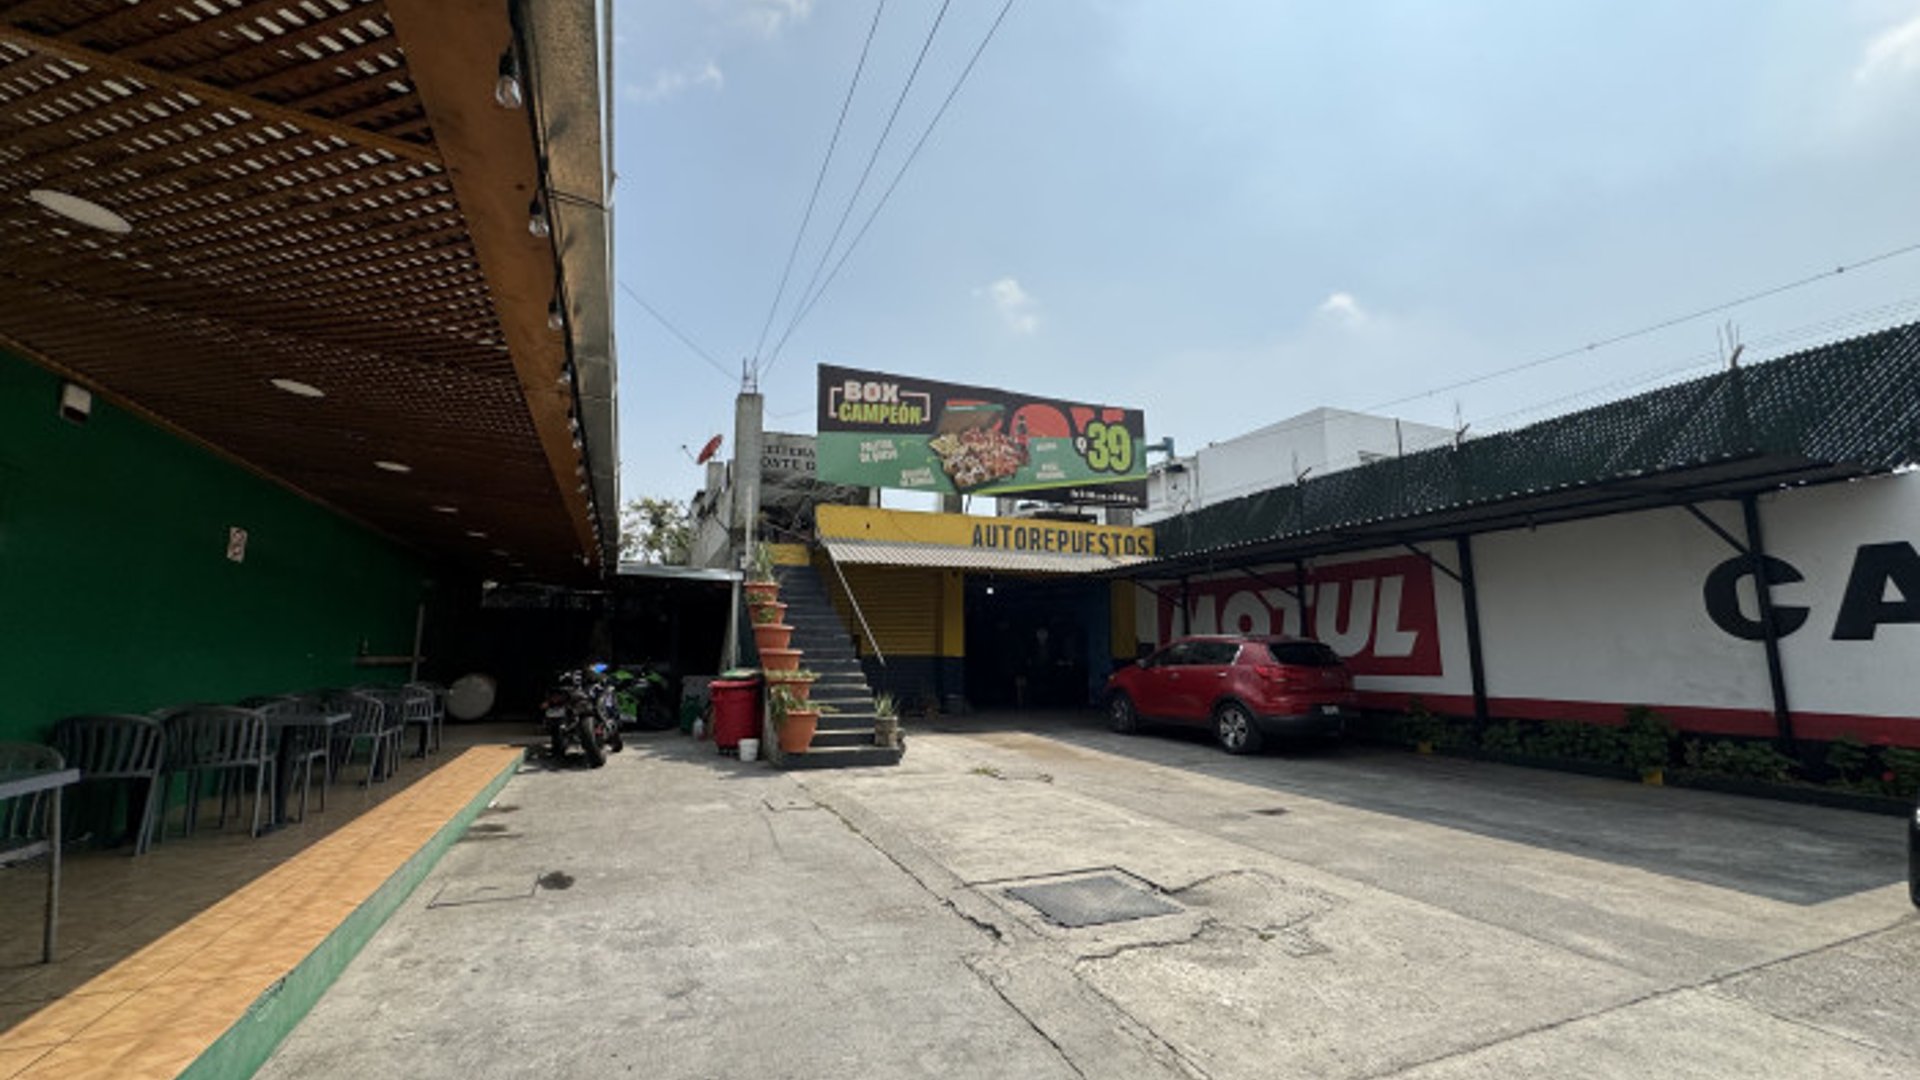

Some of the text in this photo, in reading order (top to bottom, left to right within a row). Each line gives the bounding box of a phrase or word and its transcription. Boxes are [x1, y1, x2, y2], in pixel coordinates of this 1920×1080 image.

[844, 380, 899, 402] BOX
[839, 402, 922, 425] CAMPEÓN
[973, 524, 1149, 556] AUTOREPUESTOS
[1170, 574, 1418, 657] MOTUL
